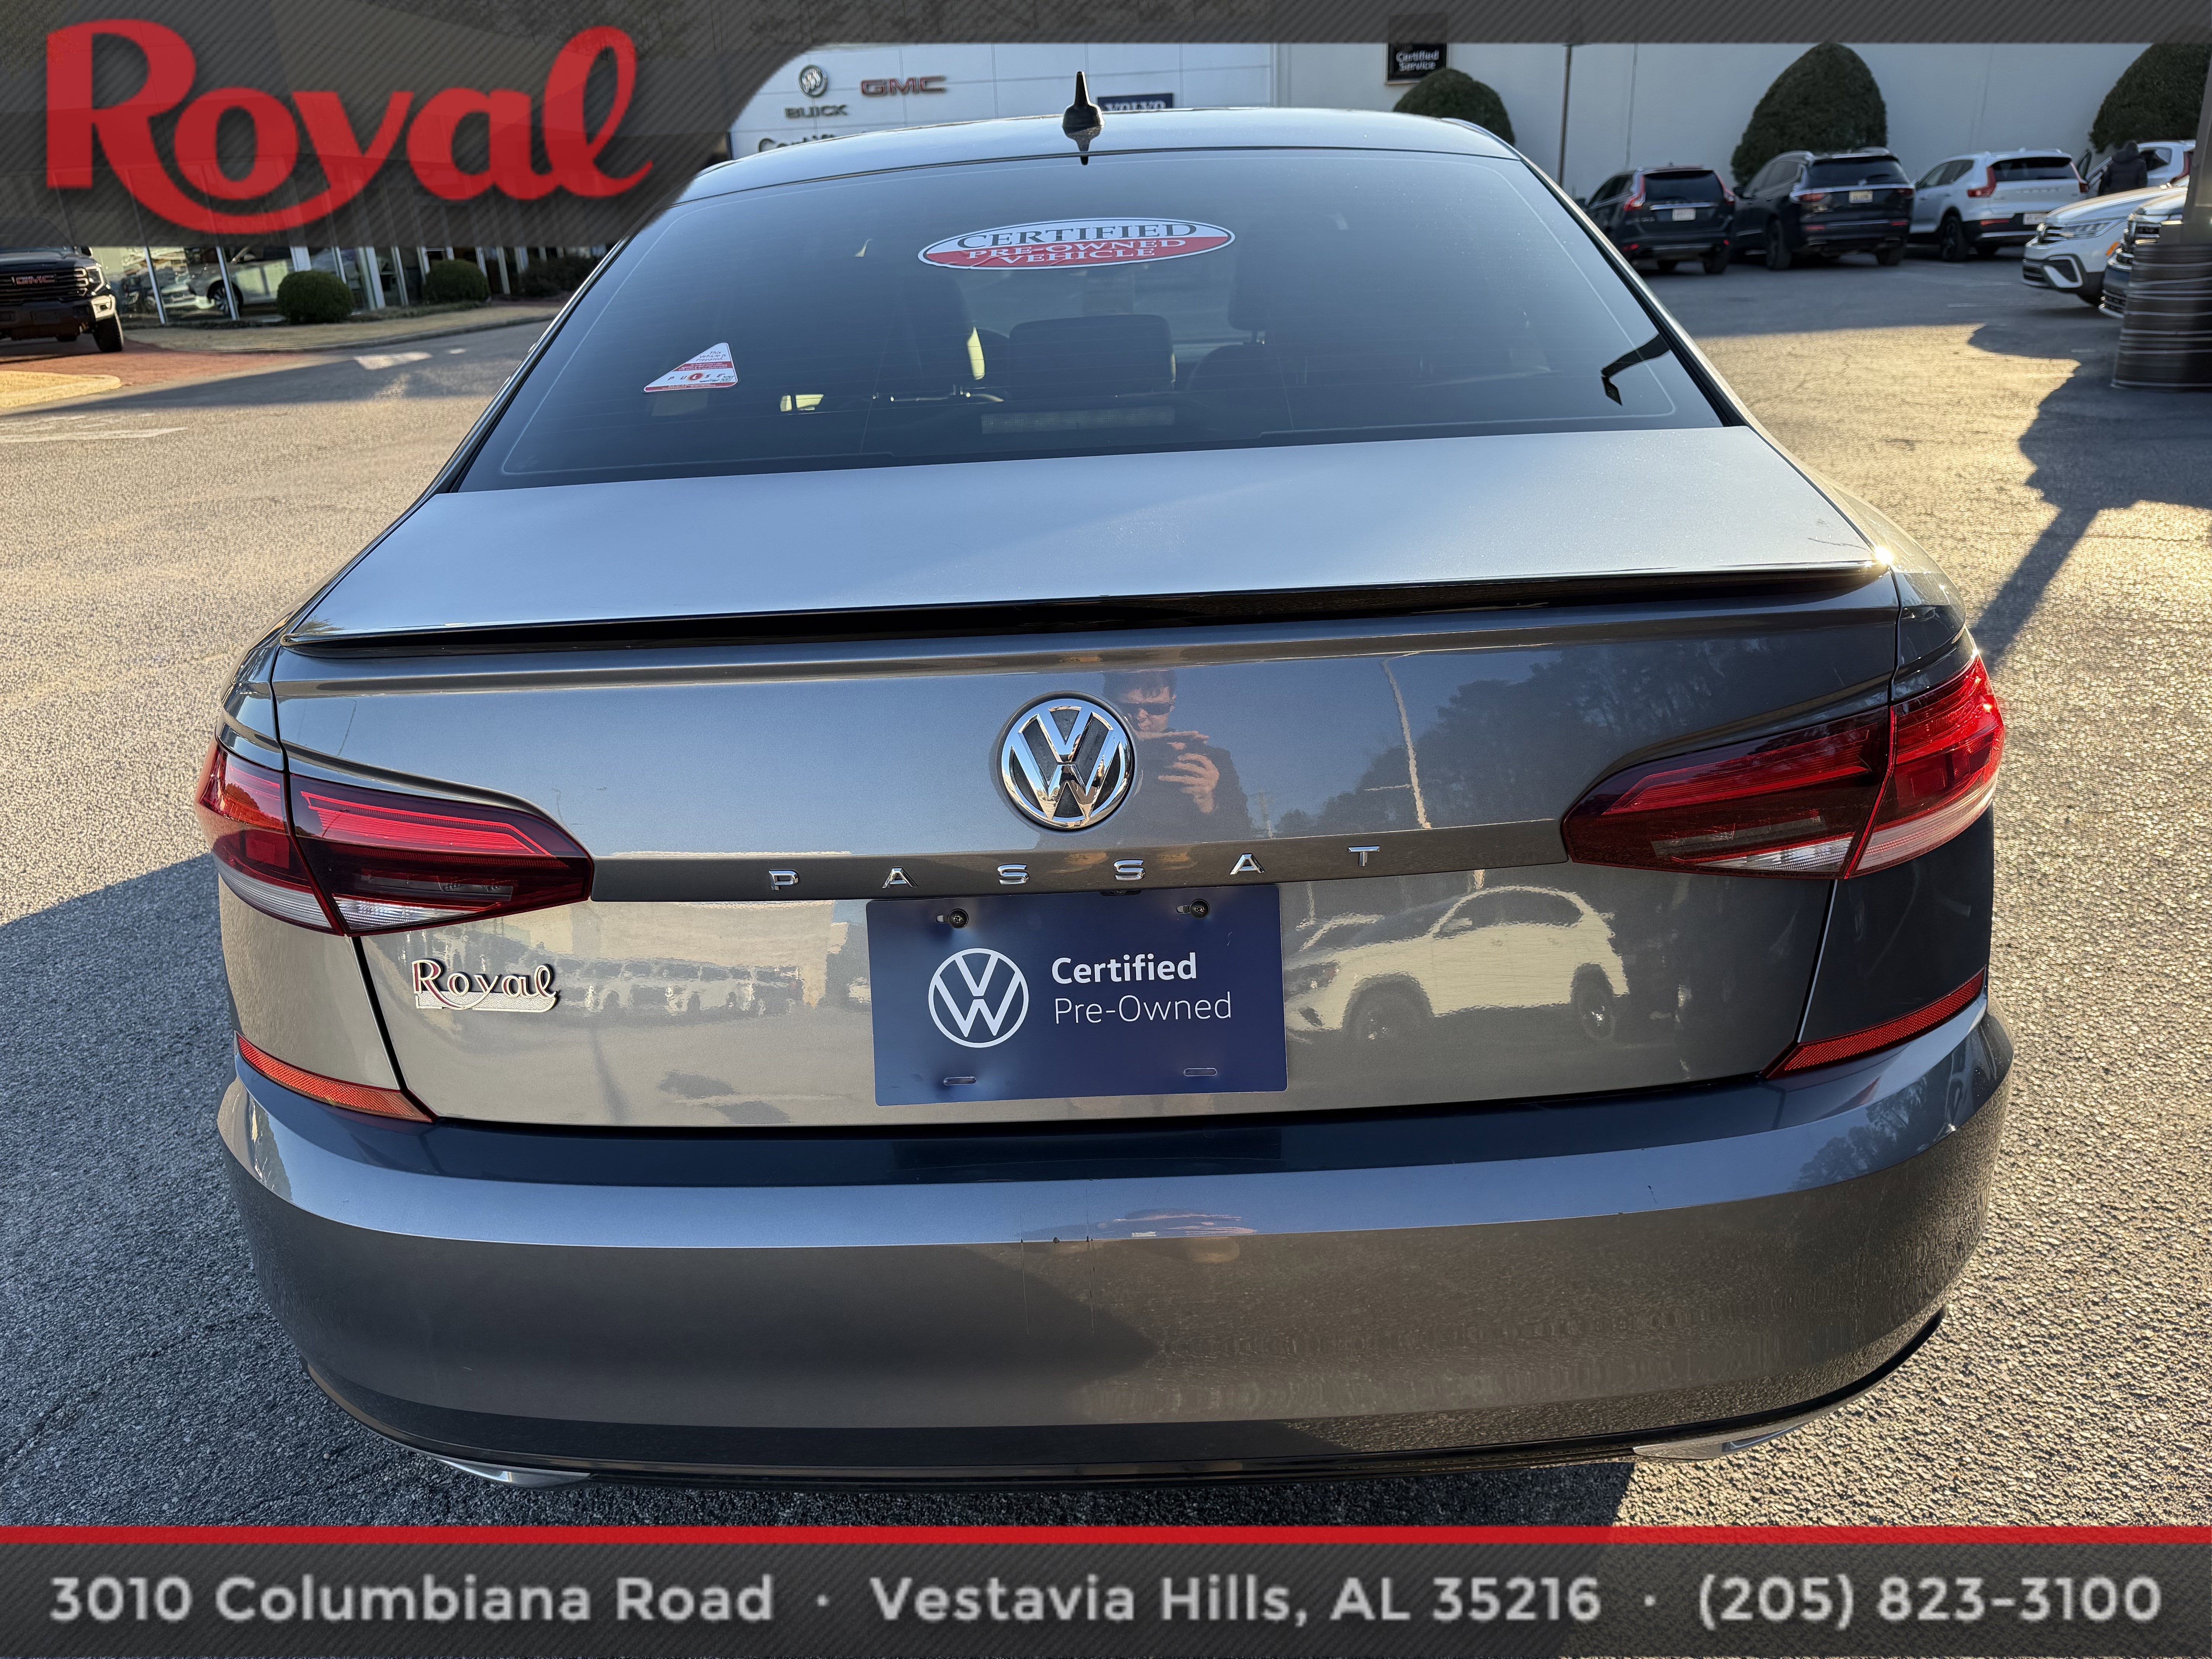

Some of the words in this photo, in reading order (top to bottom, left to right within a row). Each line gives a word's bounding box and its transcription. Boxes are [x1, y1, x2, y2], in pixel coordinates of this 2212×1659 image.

[861, 76, 946, 95] GMC
[785, 104, 848, 118] BUICK
[958, 224, 1197, 248] CERTIFIED
[967, 240, 1186, 259] PRE-OWNED
[998, 249, 1155, 263] VEHICLE
[16, 275, 55, 285] GMC
[768, 845, 1380, 890] PASSAT
[1052, 952, 1197, 984] Certified
[412, 960, 556, 1010] Royal
[1055, 991, 1231, 1024] Pre-Owned
